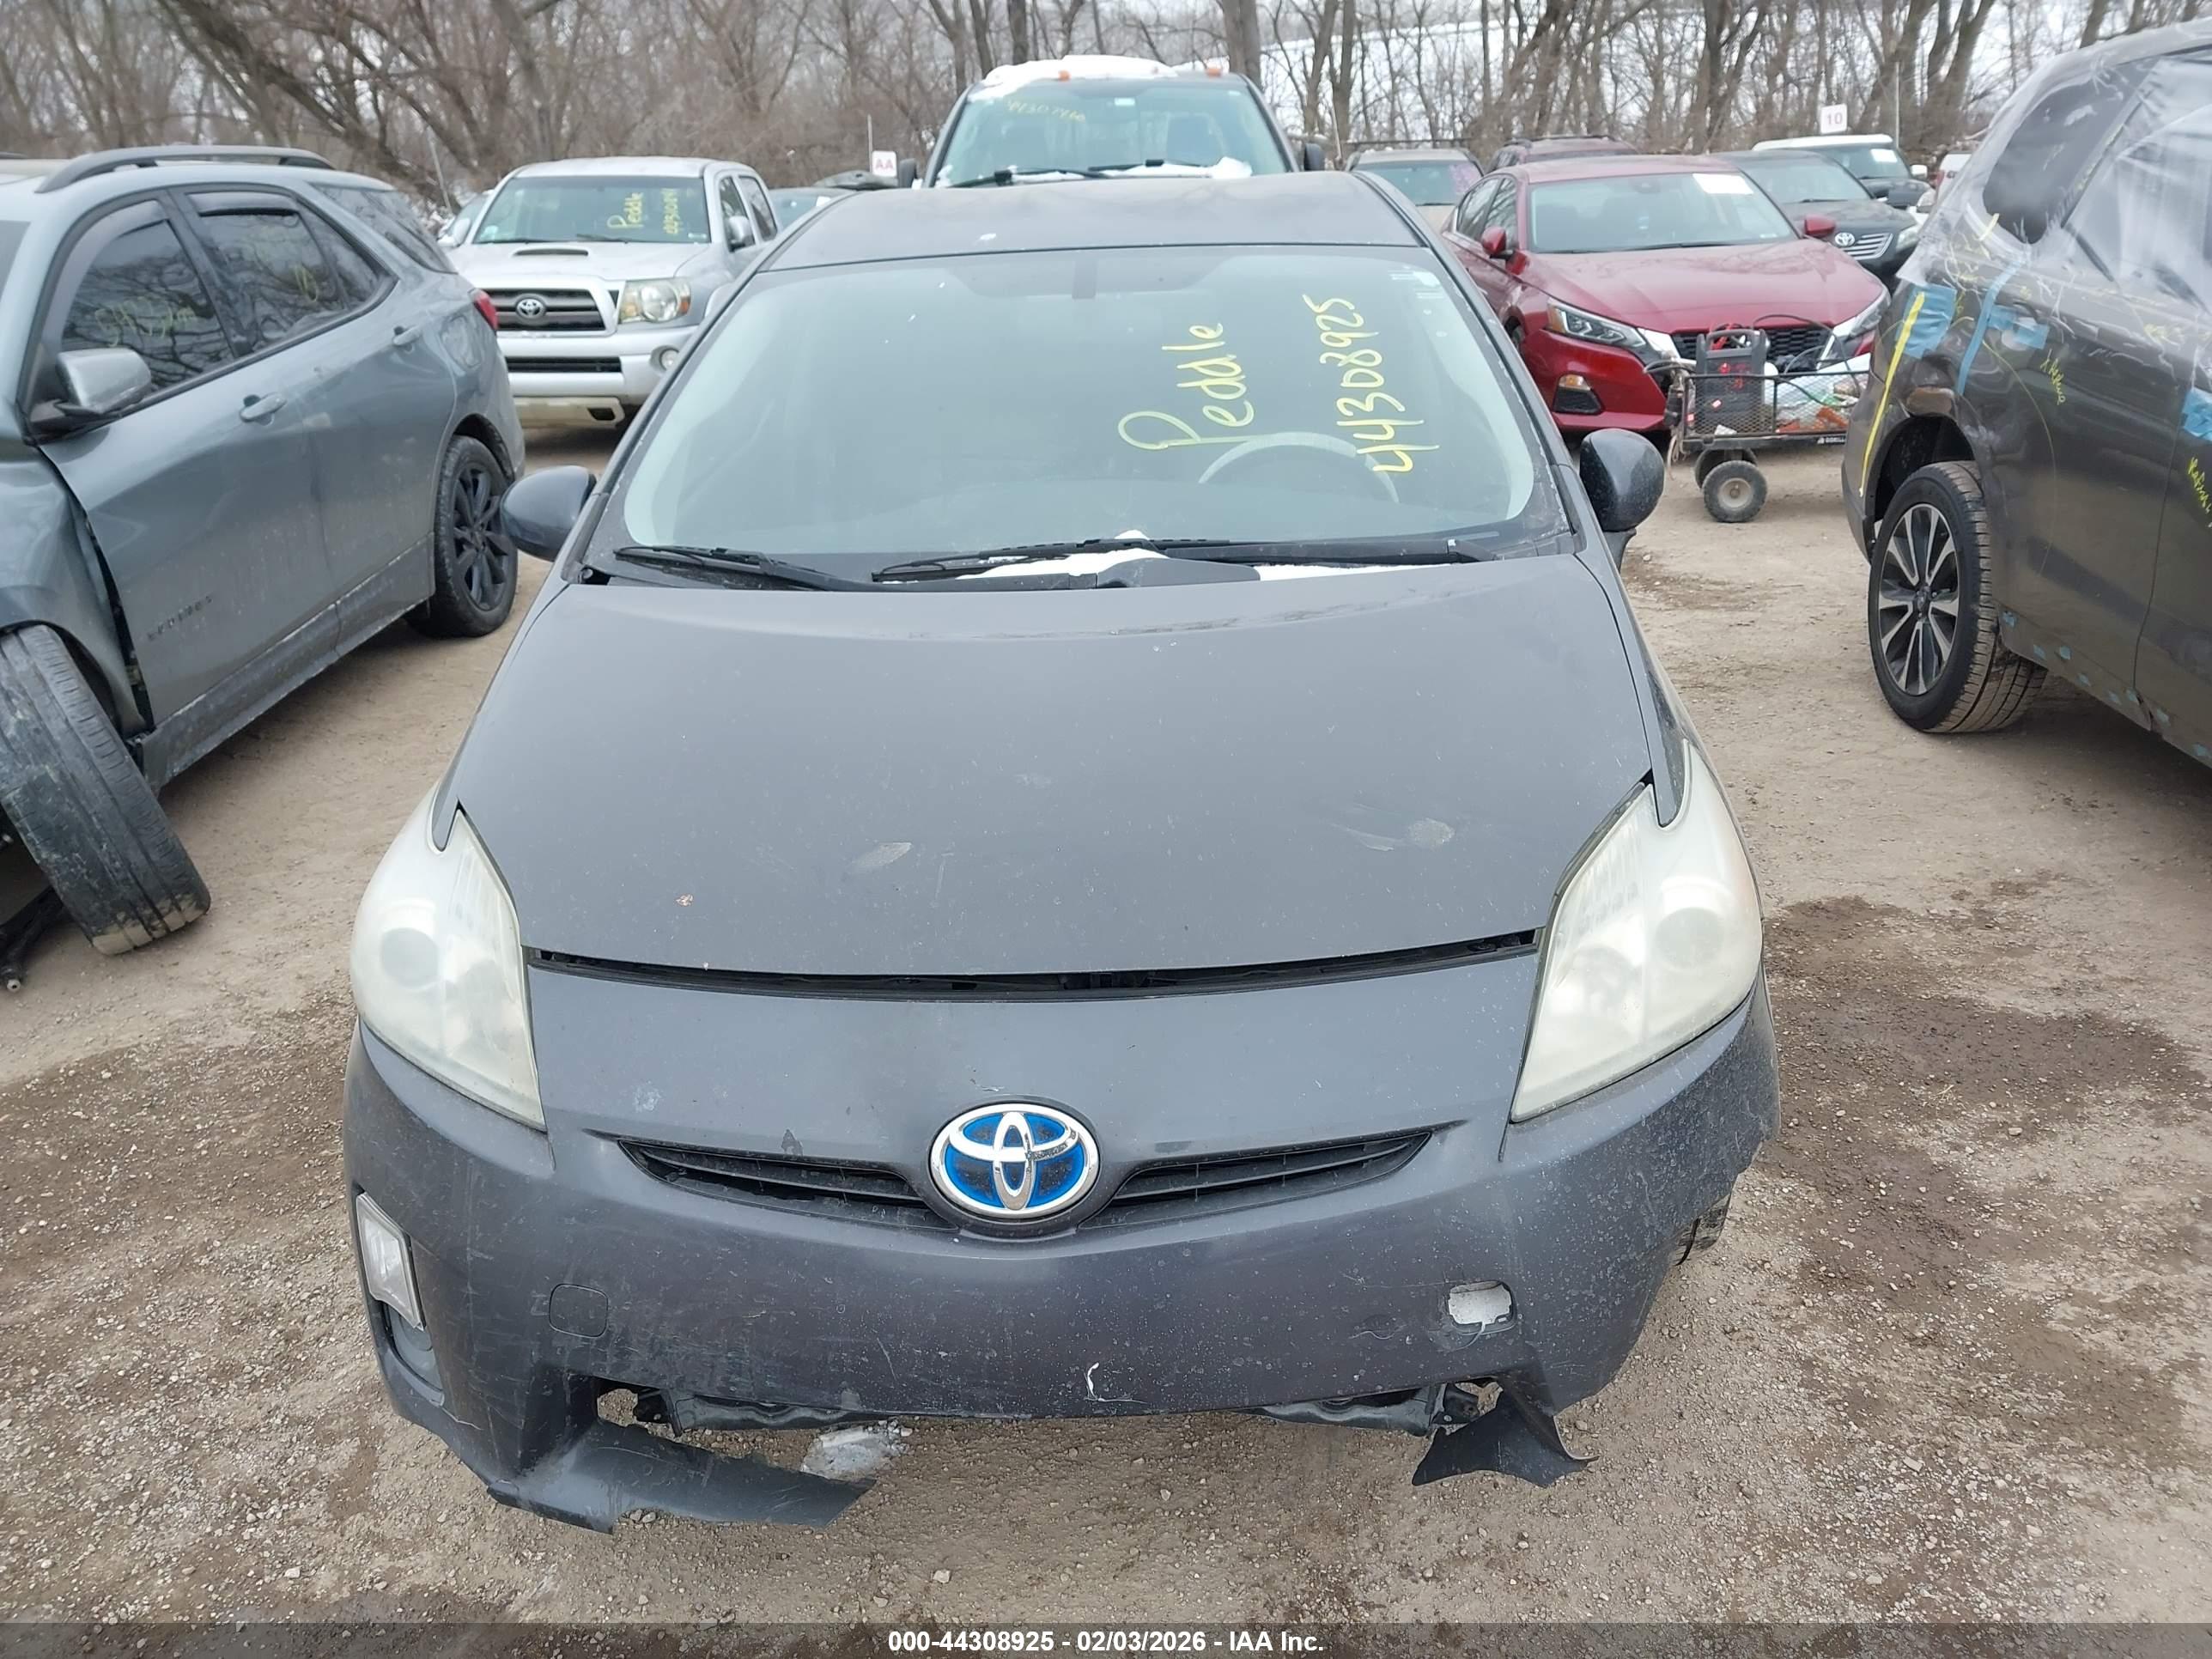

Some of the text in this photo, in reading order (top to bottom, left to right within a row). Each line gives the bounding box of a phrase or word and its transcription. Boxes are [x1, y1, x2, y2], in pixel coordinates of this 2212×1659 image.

[1826, 112, 1843, 125] 10
[875, 158, 894, 171] AA
[1118, 323, 1256, 451] Peddle
[1303, 294, 1440, 472] 44308925
